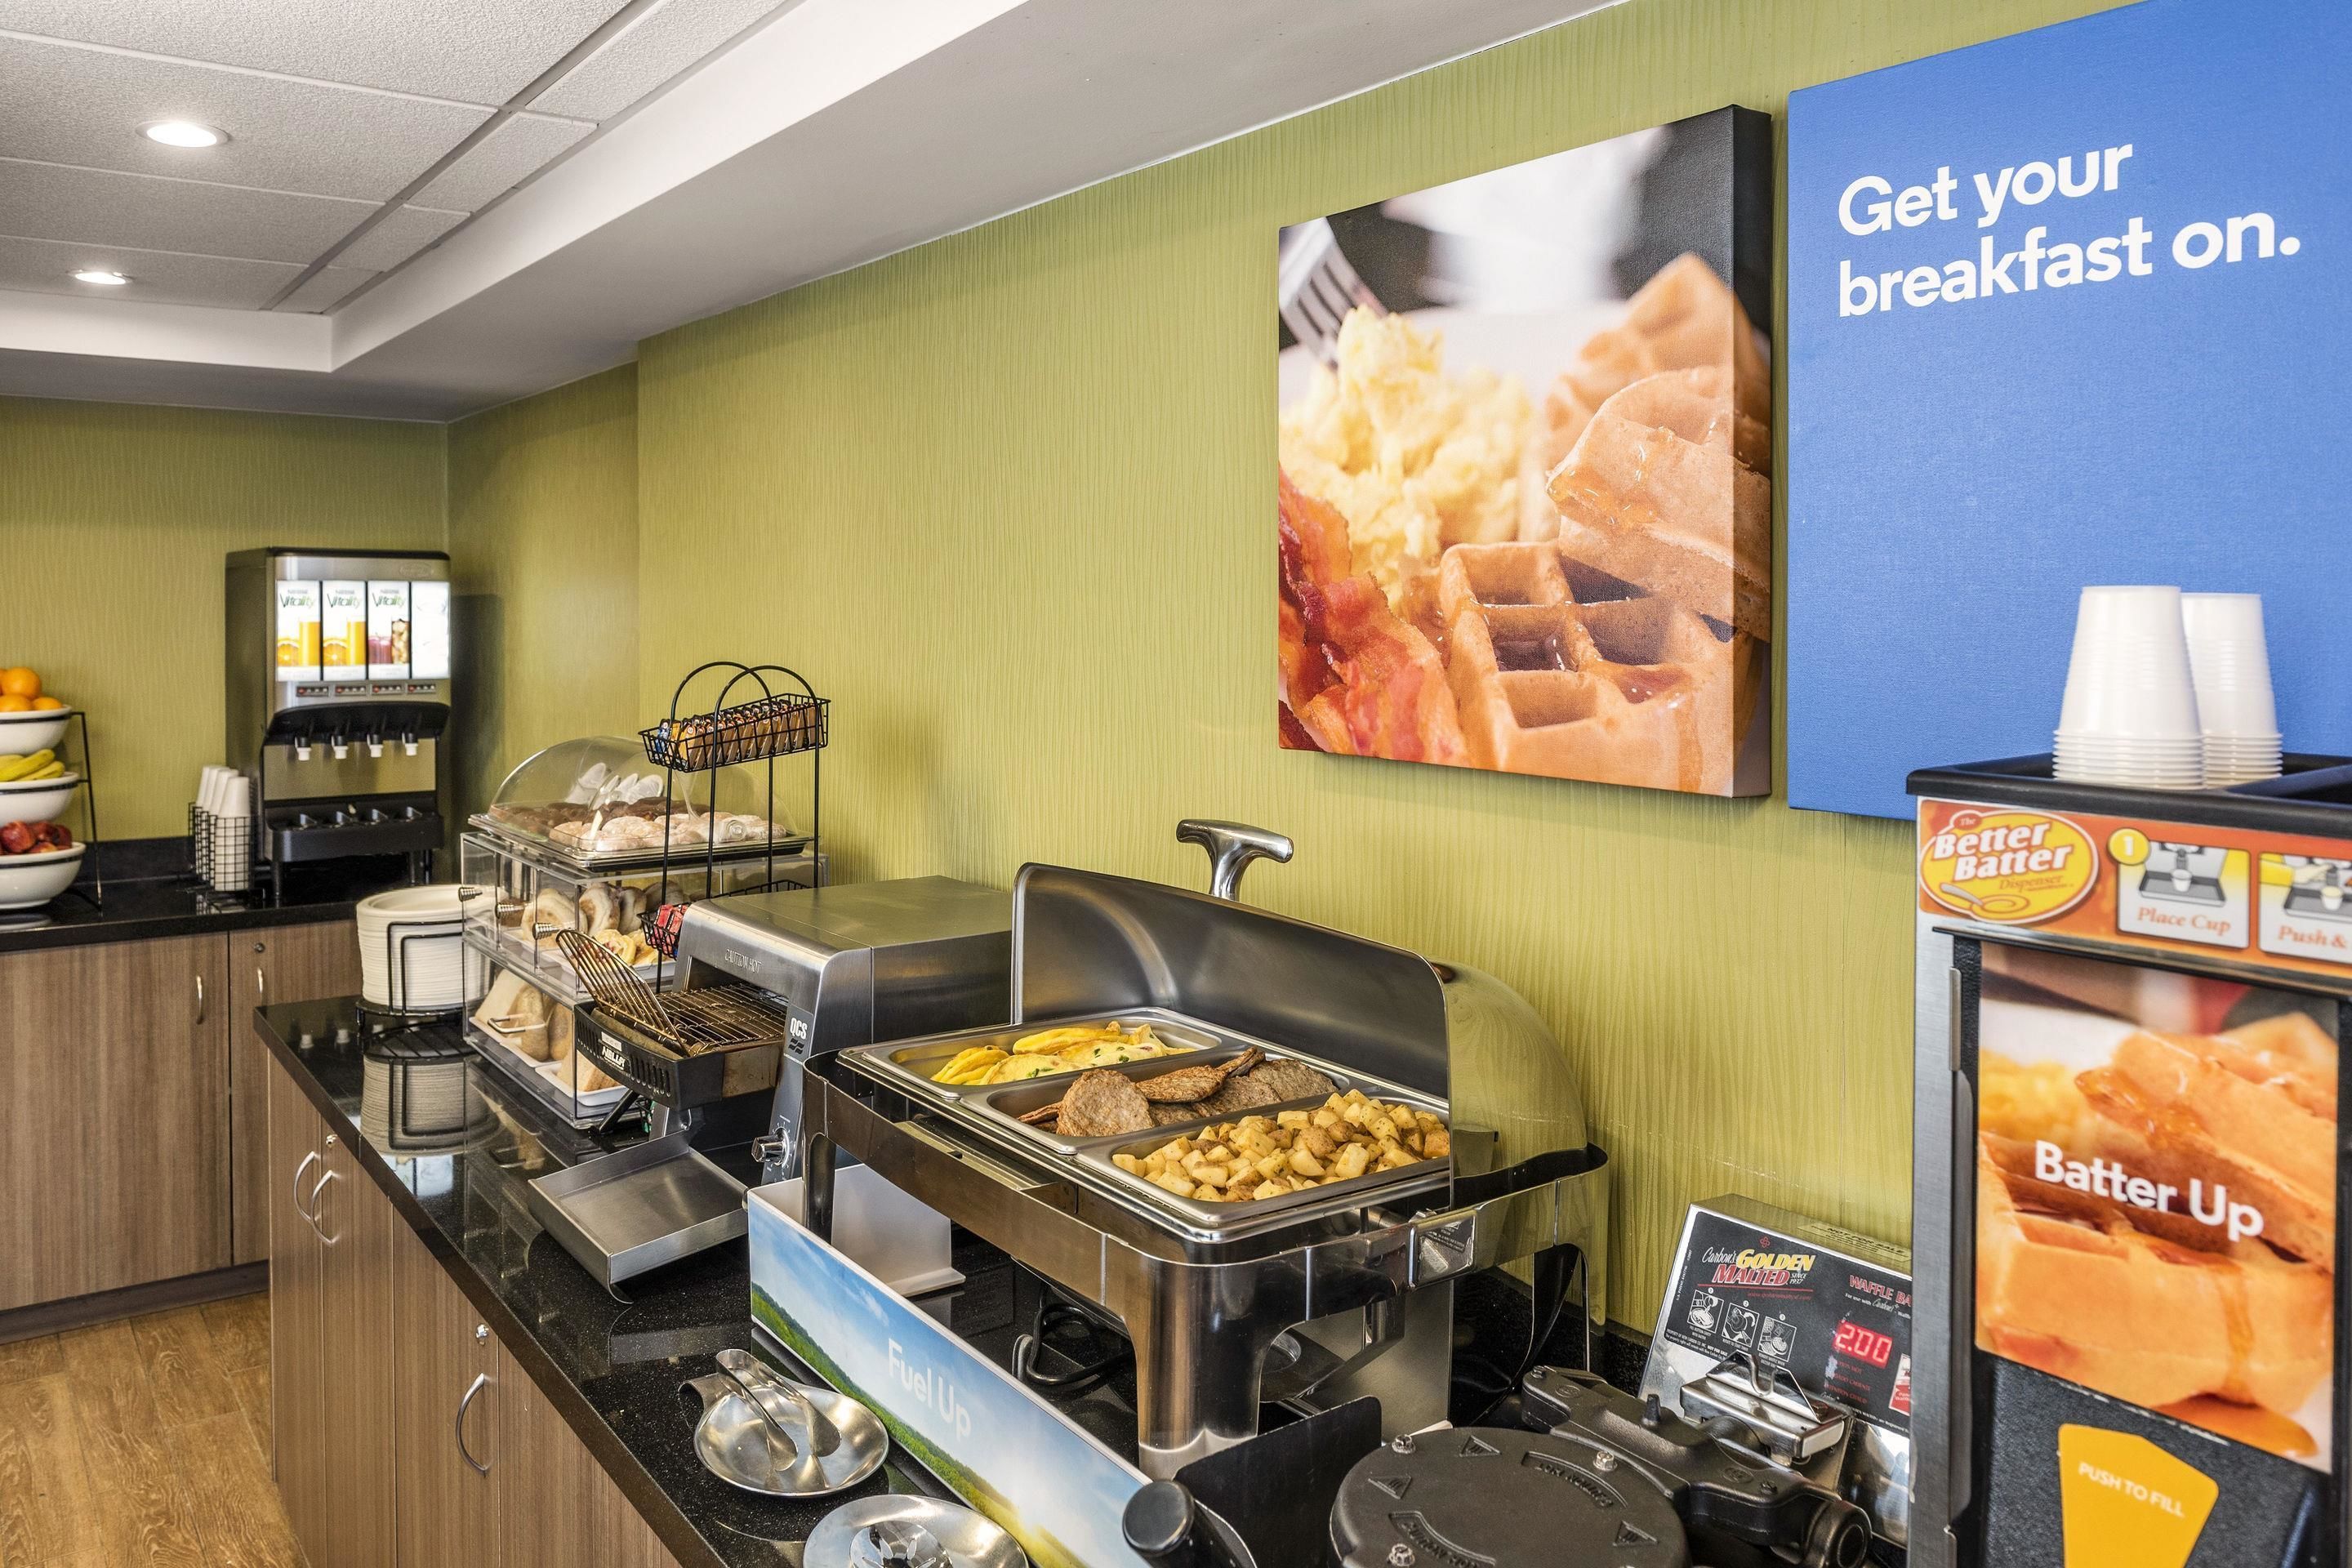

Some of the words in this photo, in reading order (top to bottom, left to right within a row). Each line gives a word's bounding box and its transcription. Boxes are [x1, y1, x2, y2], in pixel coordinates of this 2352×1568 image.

[1838, 166, 1958, 236] Get
[1973, 144, 2132, 228] your
[1839, 216, 2153, 317] breakfast
[2172, 212, 2301, 270] on.
[280, 593, 316, 608] Vitality
[327, 593, 362, 608] Vitality
[372, 593, 407, 608] Vitality
[1960, 817, 1976, 826] The
[1933, 823, 2051, 859] Better
[2123, 835, 2134, 857] 1
[1953, 845, 2074, 881] Batter
[2000, 876, 2063, 892] Dispenser
[2136, 906, 2186, 927] Place
[2191, 915, 2231, 937] Cup
[2278, 925, 2328, 946] Push
[2331, 933, 2347, 949] &
[790, 1018, 808, 1040] QCS
[2035, 1139, 2178, 1213] Batter
[2189, 1178, 2264, 1242] Up
[1702, 1246, 1736, 1264] Carbon's
[1736, 1249, 1815, 1272] GOLDEN
[1712, 1264, 1789, 1285] MALTED
[1849, 1275, 1894, 1300] WAFFLE
[889, 1338, 933, 1409] Fuel
[938, 1375, 972, 1441] Up
[2078, 1461, 2122, 1491] PUSH
[2123, 1479, 2149, 1501] TO
[2149, 1490, 2185, 1518] FILL
